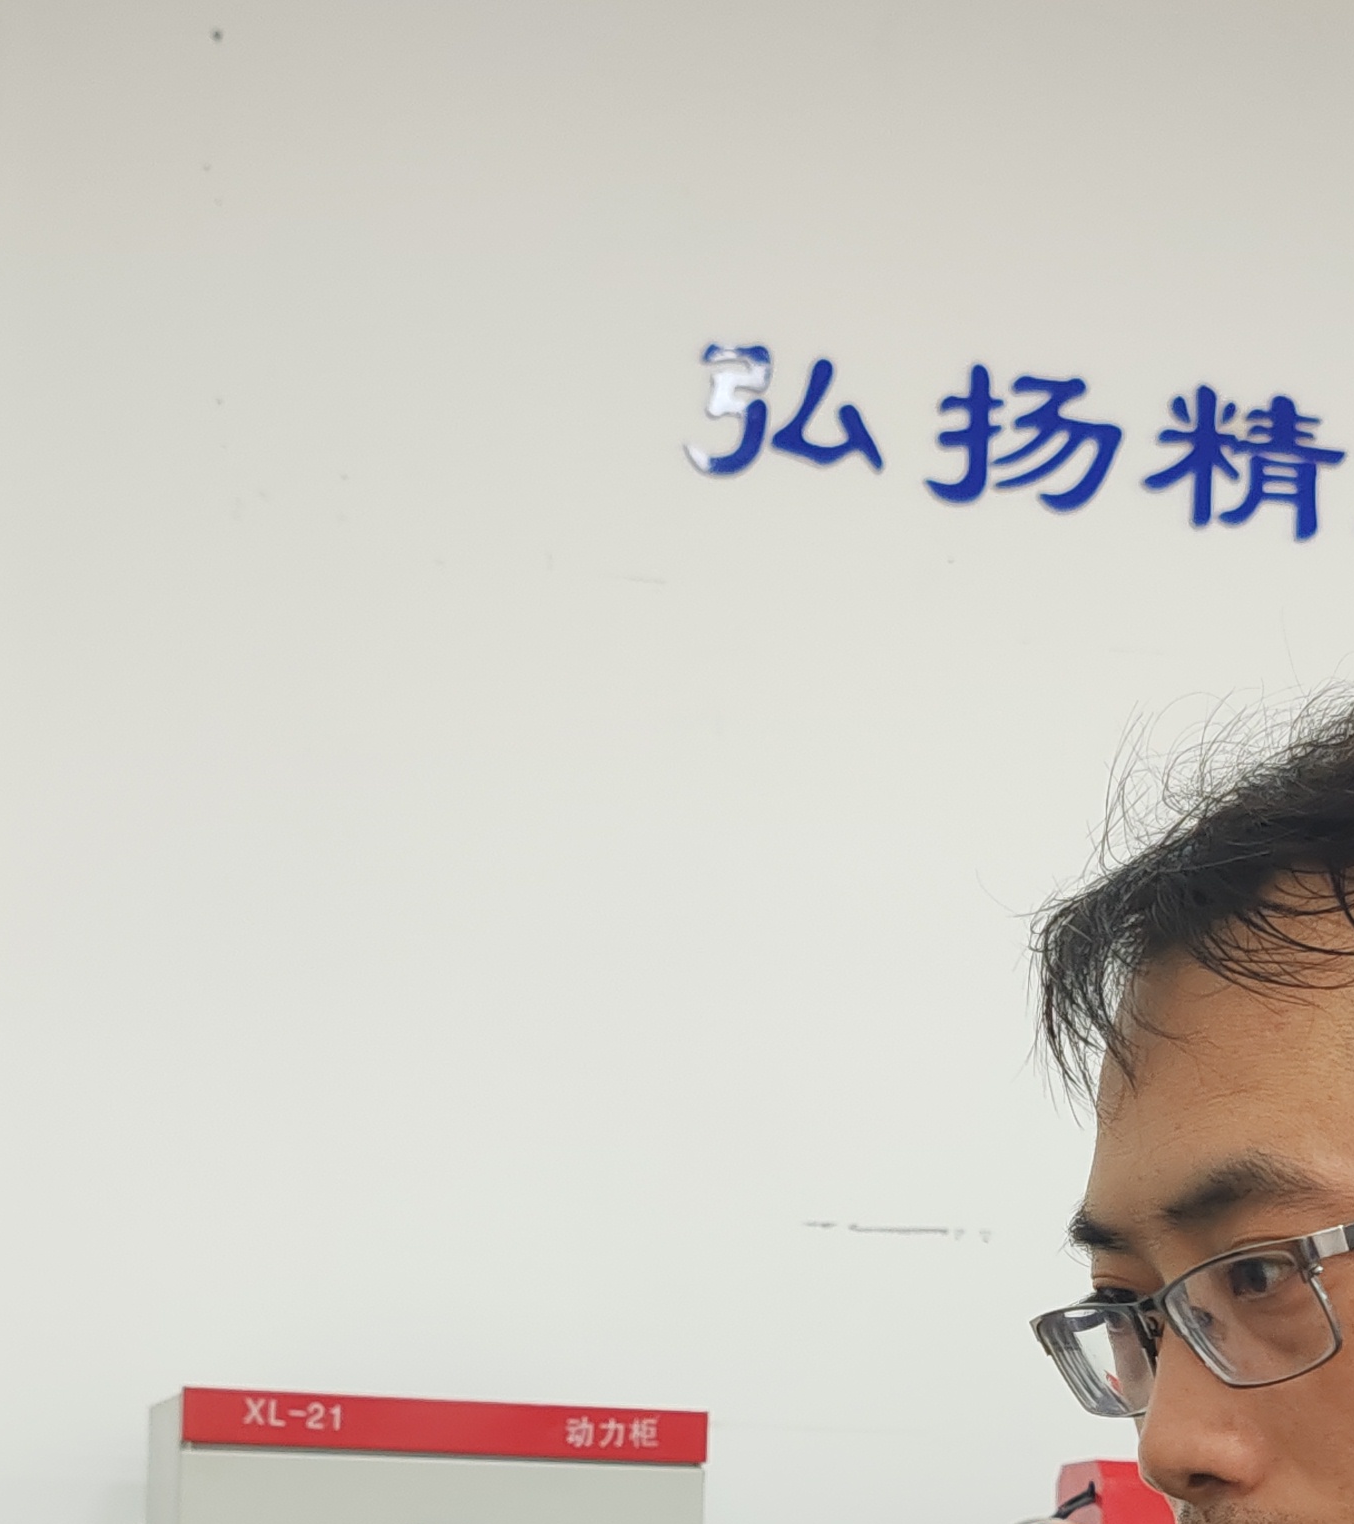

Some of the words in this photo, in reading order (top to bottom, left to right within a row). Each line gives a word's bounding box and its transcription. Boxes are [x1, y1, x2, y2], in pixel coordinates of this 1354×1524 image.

[242, 1396, 343, 1431] XL-21
[564, 1414, 661, 1450] 动力柜
